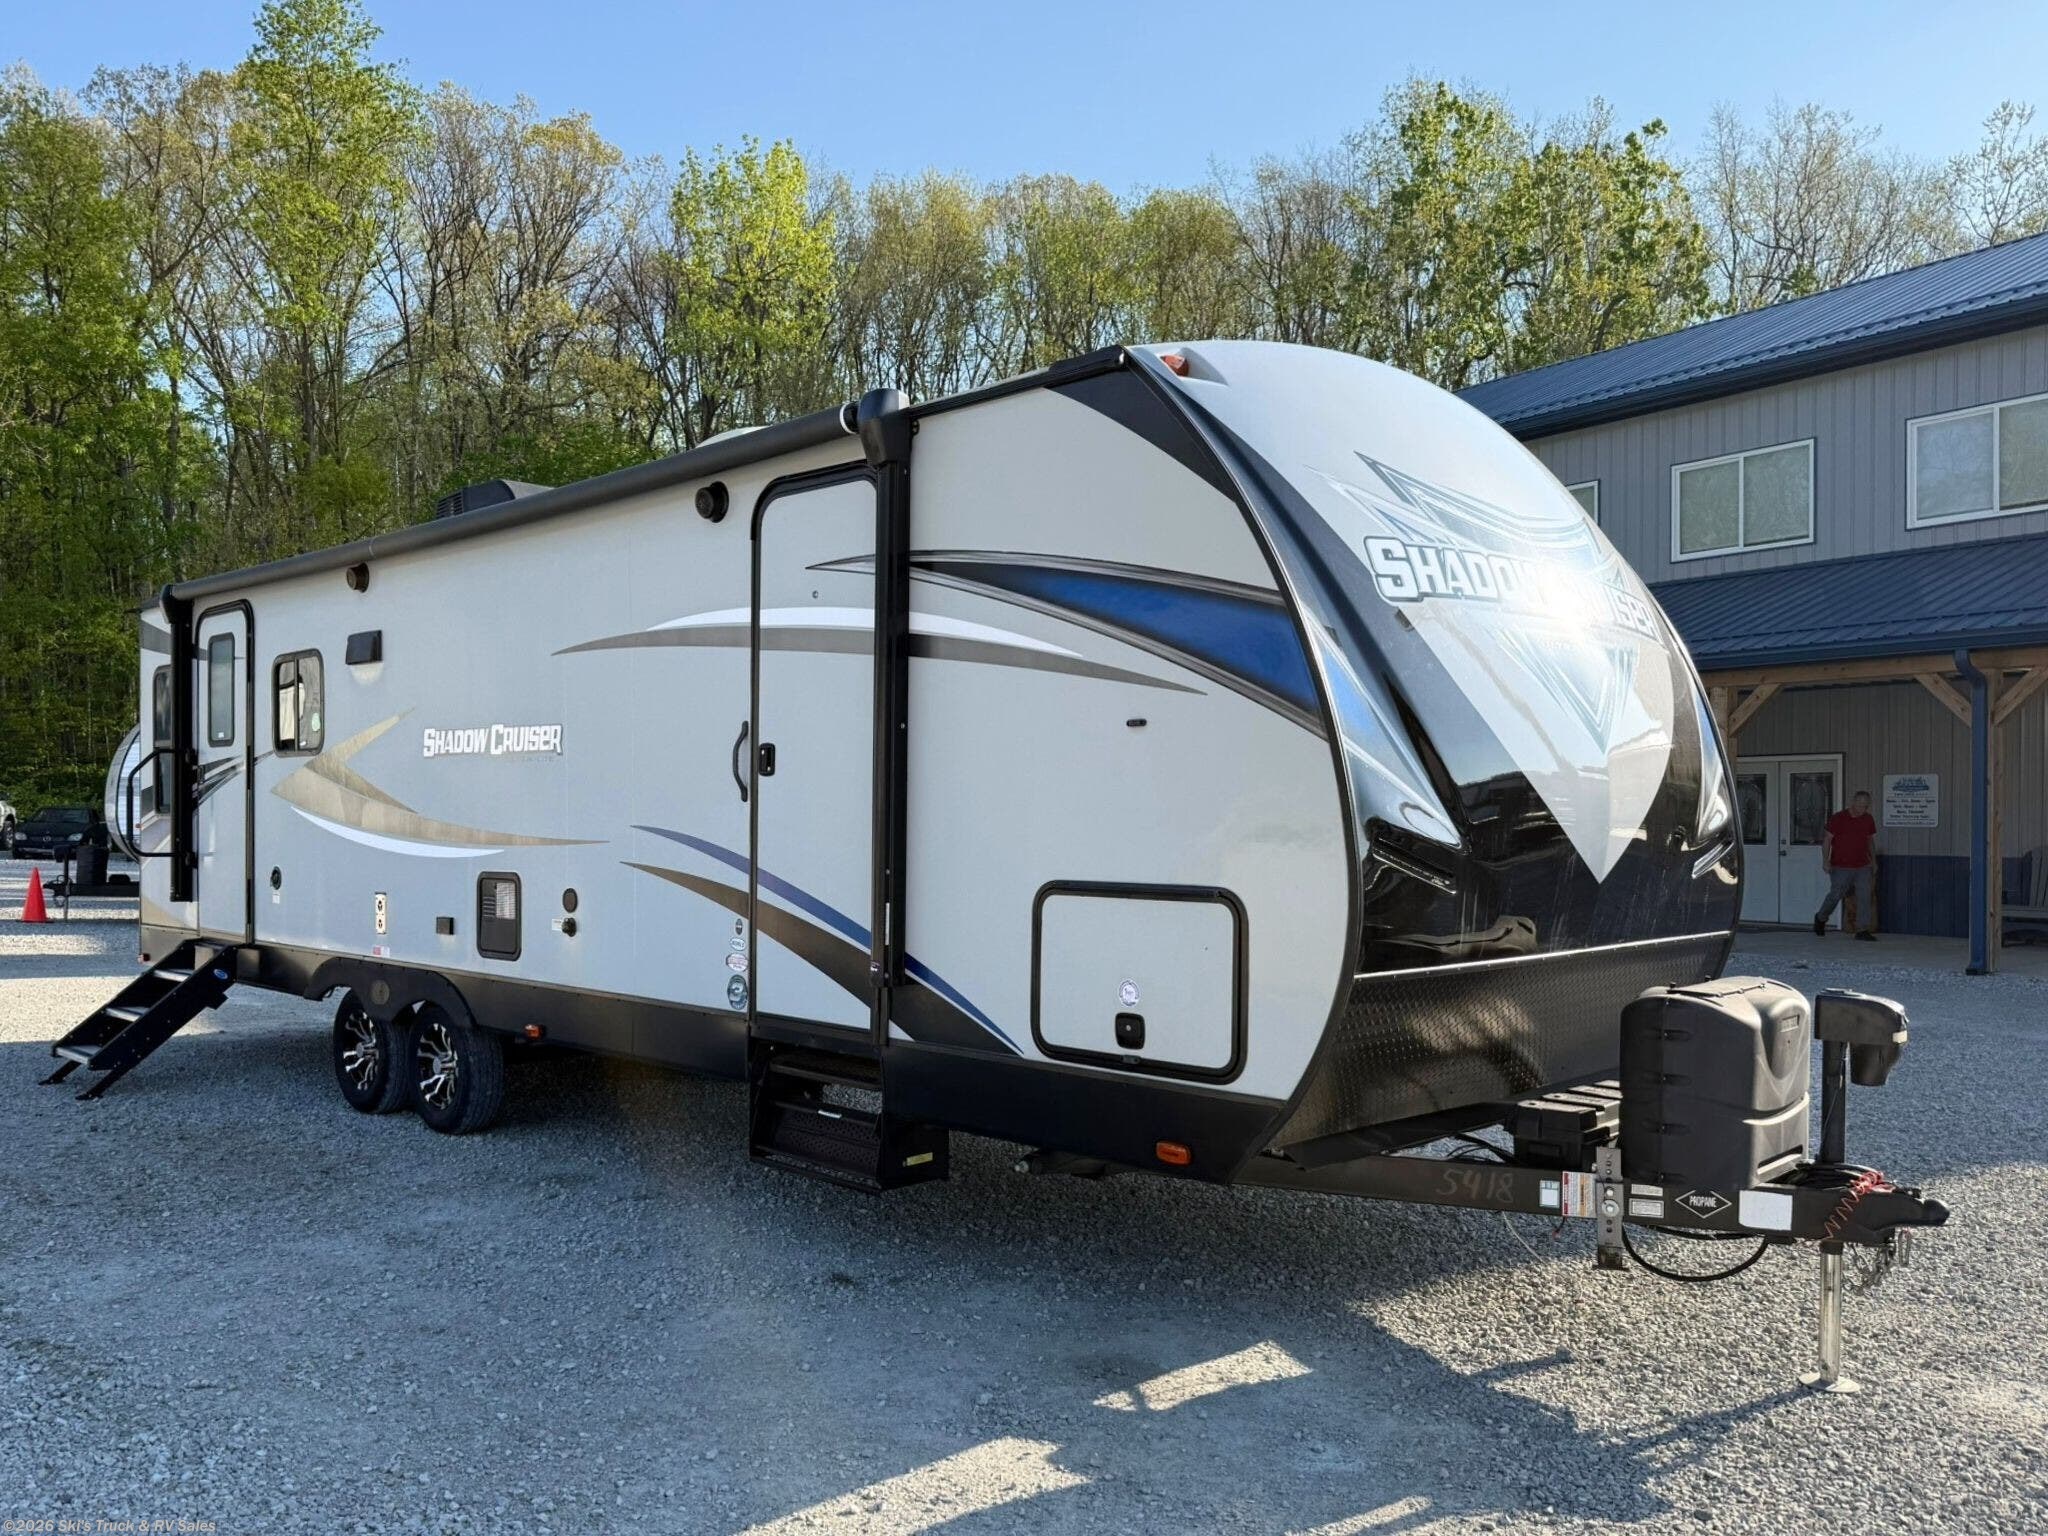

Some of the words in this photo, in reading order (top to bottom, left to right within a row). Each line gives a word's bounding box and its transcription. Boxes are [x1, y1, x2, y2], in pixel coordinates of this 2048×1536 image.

[423, 728, 489, 757] SHADOW
[490, 724, 563, 756] CRUISER
[1435, 1168, 1514, 1203] 5418
[1689, 1195, 1717, 1208] PROPANE
